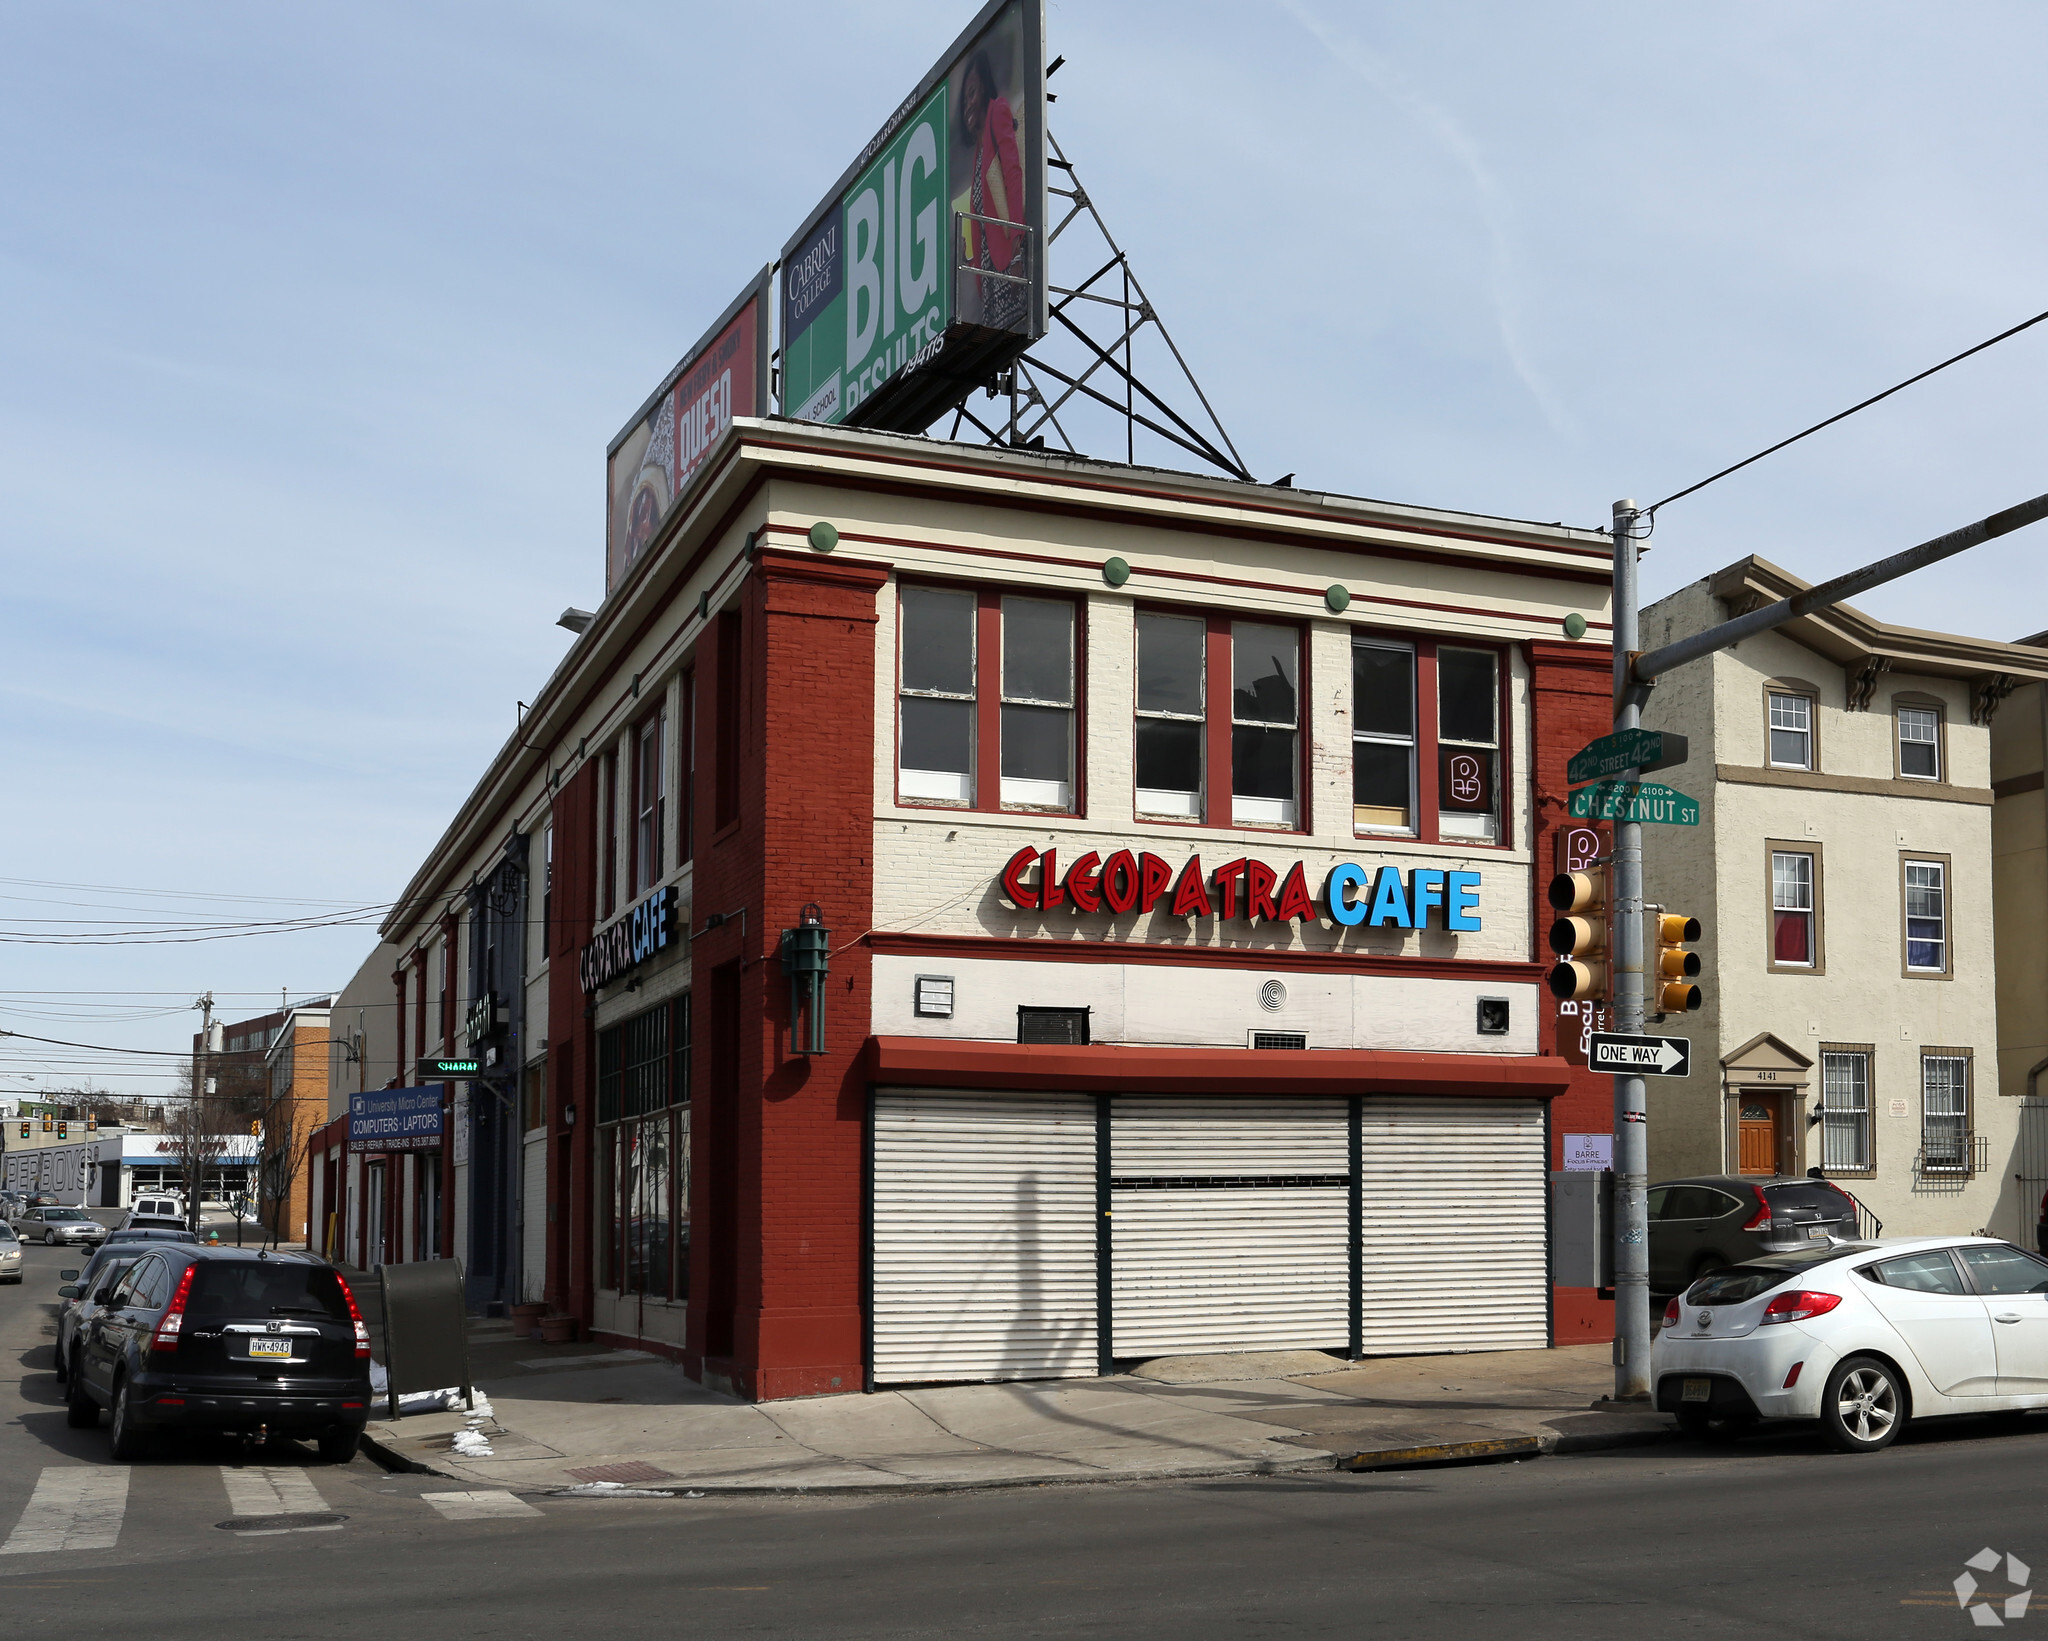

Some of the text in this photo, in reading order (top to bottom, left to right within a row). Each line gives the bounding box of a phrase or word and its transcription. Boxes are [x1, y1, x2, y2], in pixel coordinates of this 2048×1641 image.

[847, 121, 937, 375] BIG
[789, 225, 836, 301] CABRINI
[794, 266, 832, 319] COLLEGE
[812, 387, 837, 420] SCHOOL
[680, 367, 732, 473] QUESO
[1600, 752, 1630, 774] STREET
[1608, 784, 1664, 796] 4200 W 4100
[1575, 794, 1696, 823] CHESTNUT ST
[1000, 845, 1482, 932] CLEOPATRA CAFE
[632, 887, 668, 964] CAFE
[1600, 1045, 1660, 1063] ONE WAY
[1757, 1071, 1777, 1081] 4141
[368, 1094, 439, 1114] University Micro Center
[353, 1113, 438, 1135] COMPUTERS LAPTOPS
[350, 1141, 365, 1151] SALES
[367, 1139, 384, 1149] REPAIR
[1575, 1150, 1600, 1159] BARRE
[7, 1148, 92, 1192] PEP BOYS
